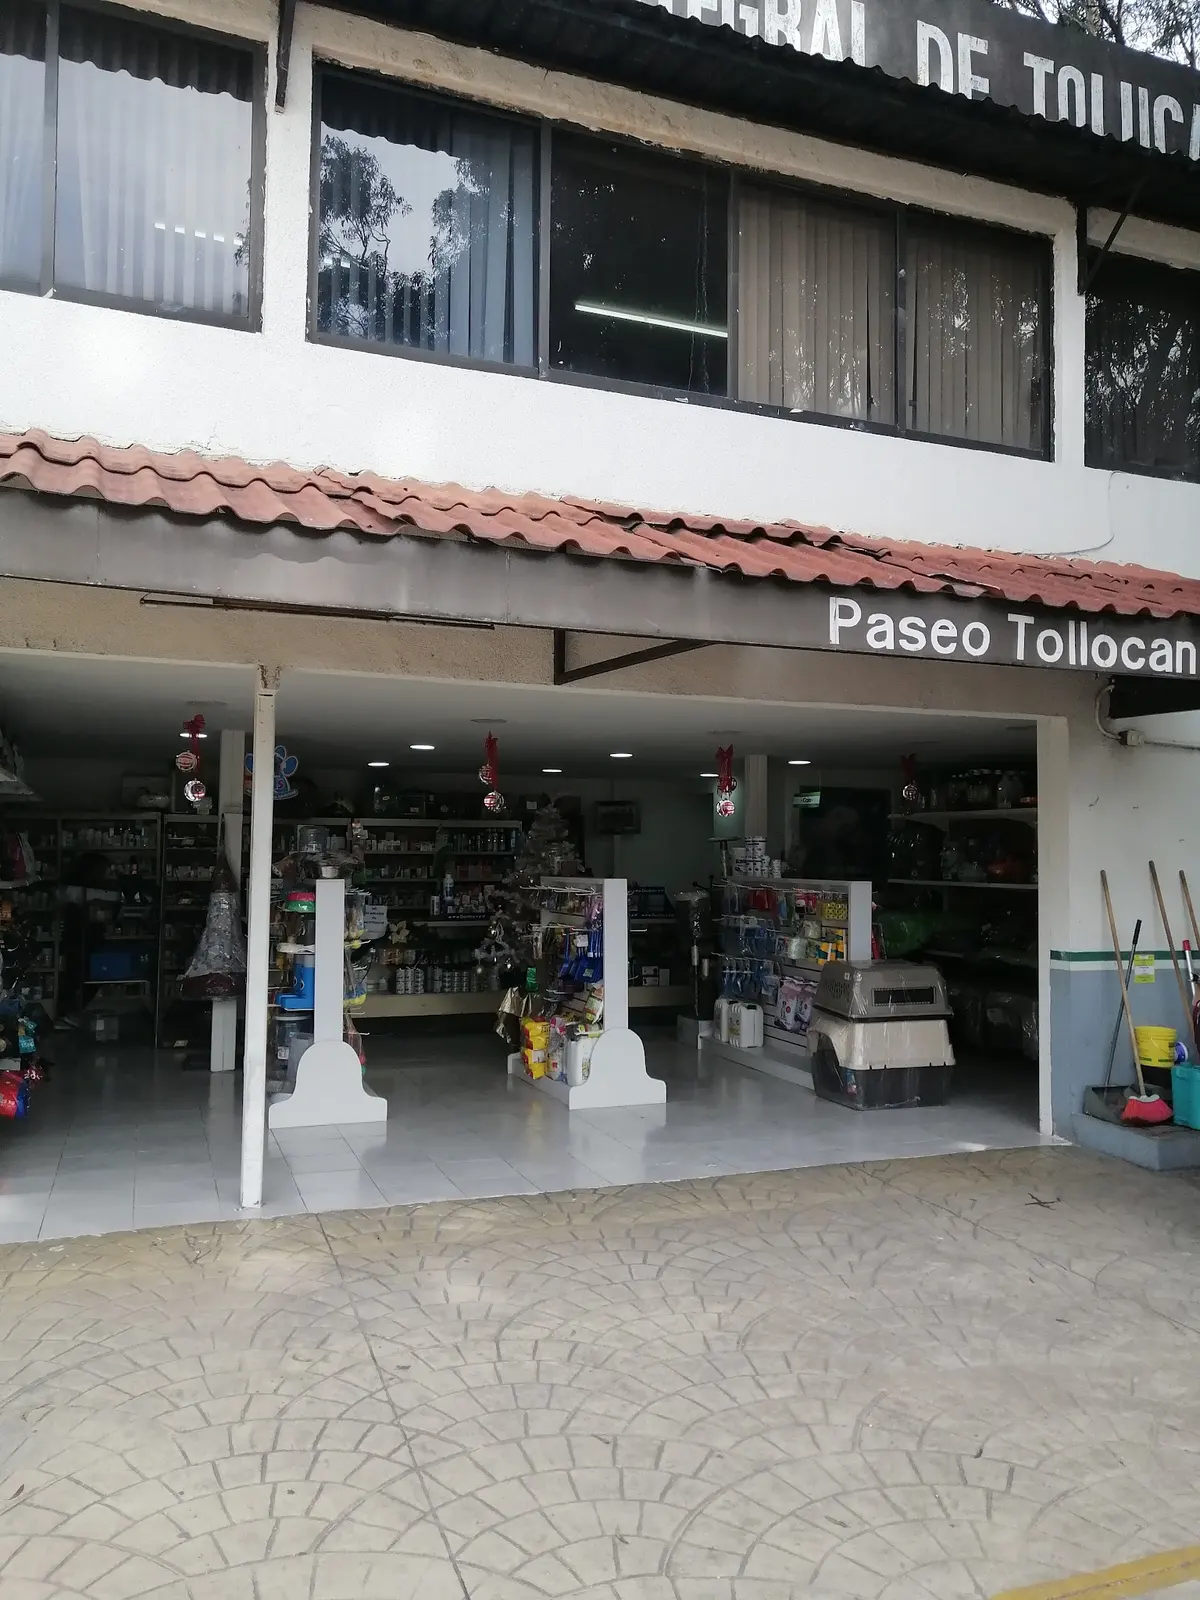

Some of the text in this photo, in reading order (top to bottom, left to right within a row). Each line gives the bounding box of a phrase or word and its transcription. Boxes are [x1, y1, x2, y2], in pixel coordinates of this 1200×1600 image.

[916, 19, 991, 100] DE
[828, 596, 1197, 675] Paseo Tollocan
